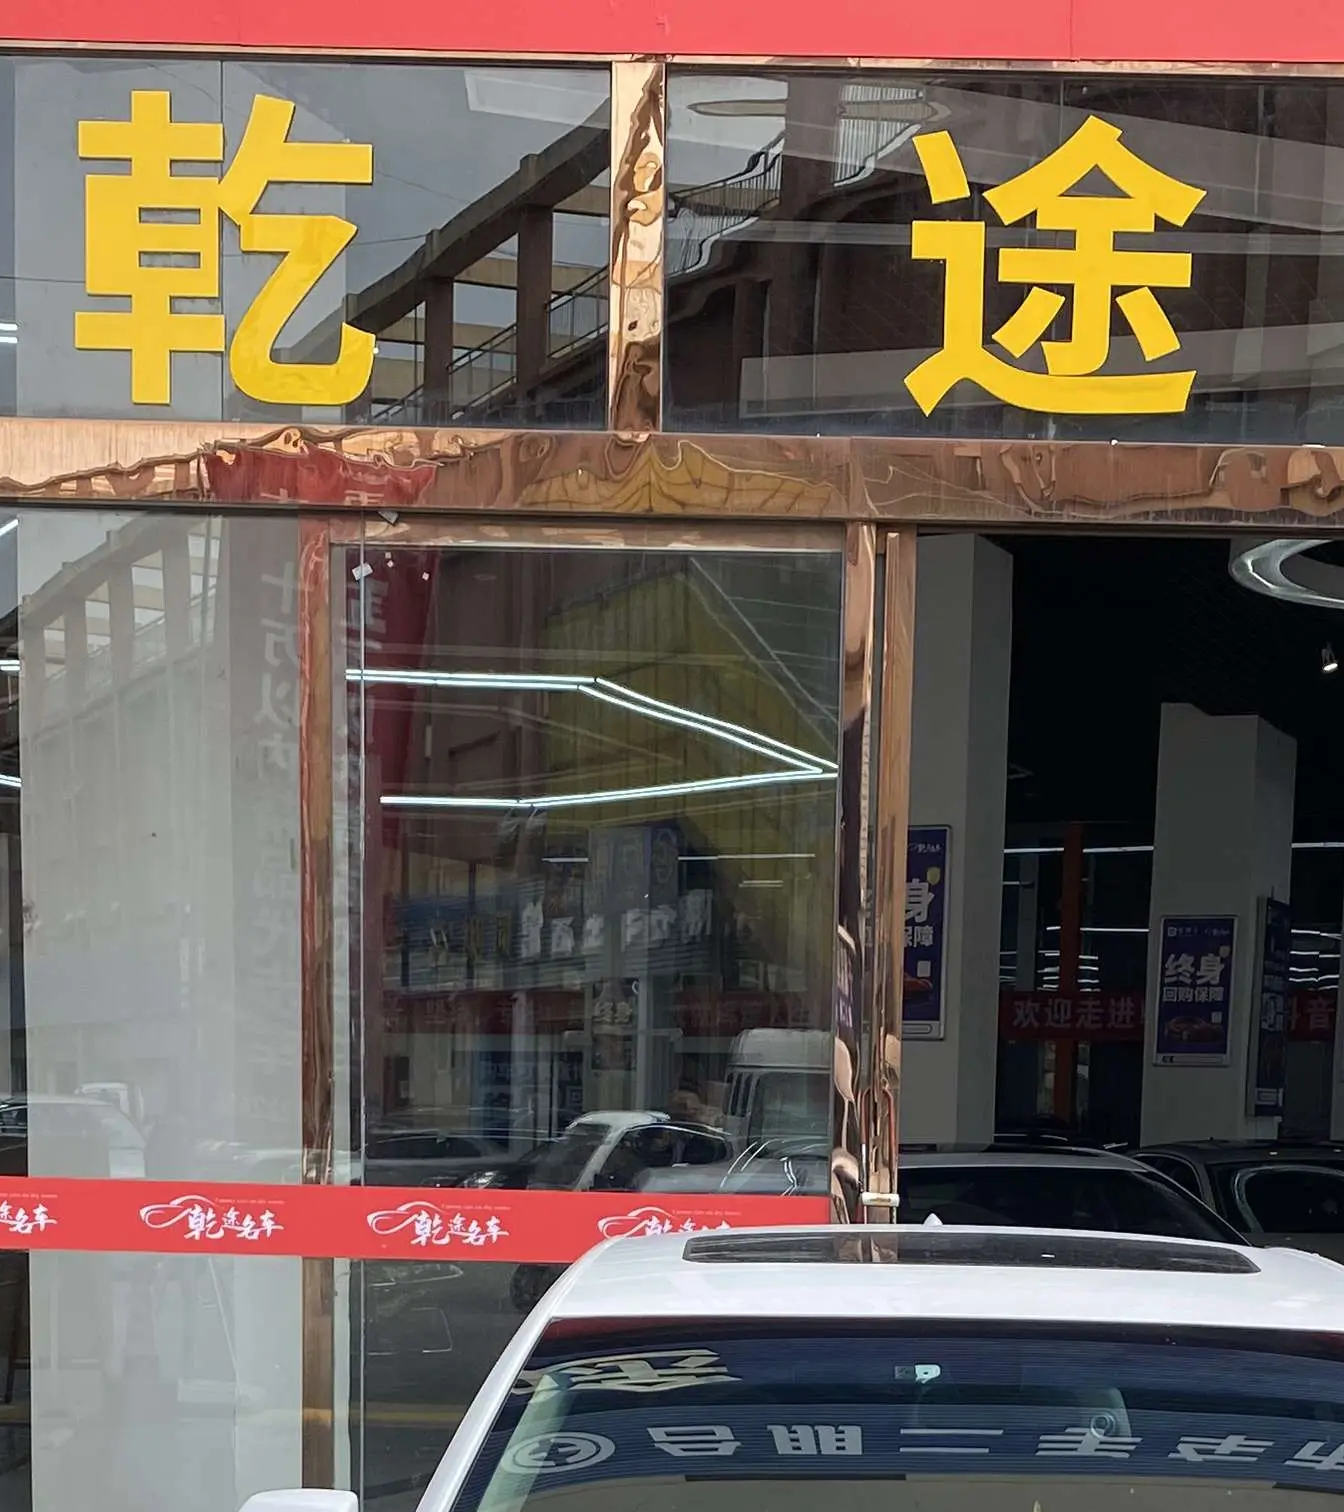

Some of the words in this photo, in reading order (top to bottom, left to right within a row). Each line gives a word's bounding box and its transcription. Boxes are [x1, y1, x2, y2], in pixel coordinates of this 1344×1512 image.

[1163, 952, 1225, 985] 终身
[1162, 986, 1225, 1003] 回购保障
[1012, 998, 1147, 1031] 欢迎走进
[183, 1203, 285, 1241] 乾途名车
[410, 1210, 510, 1246] 乾途名车
